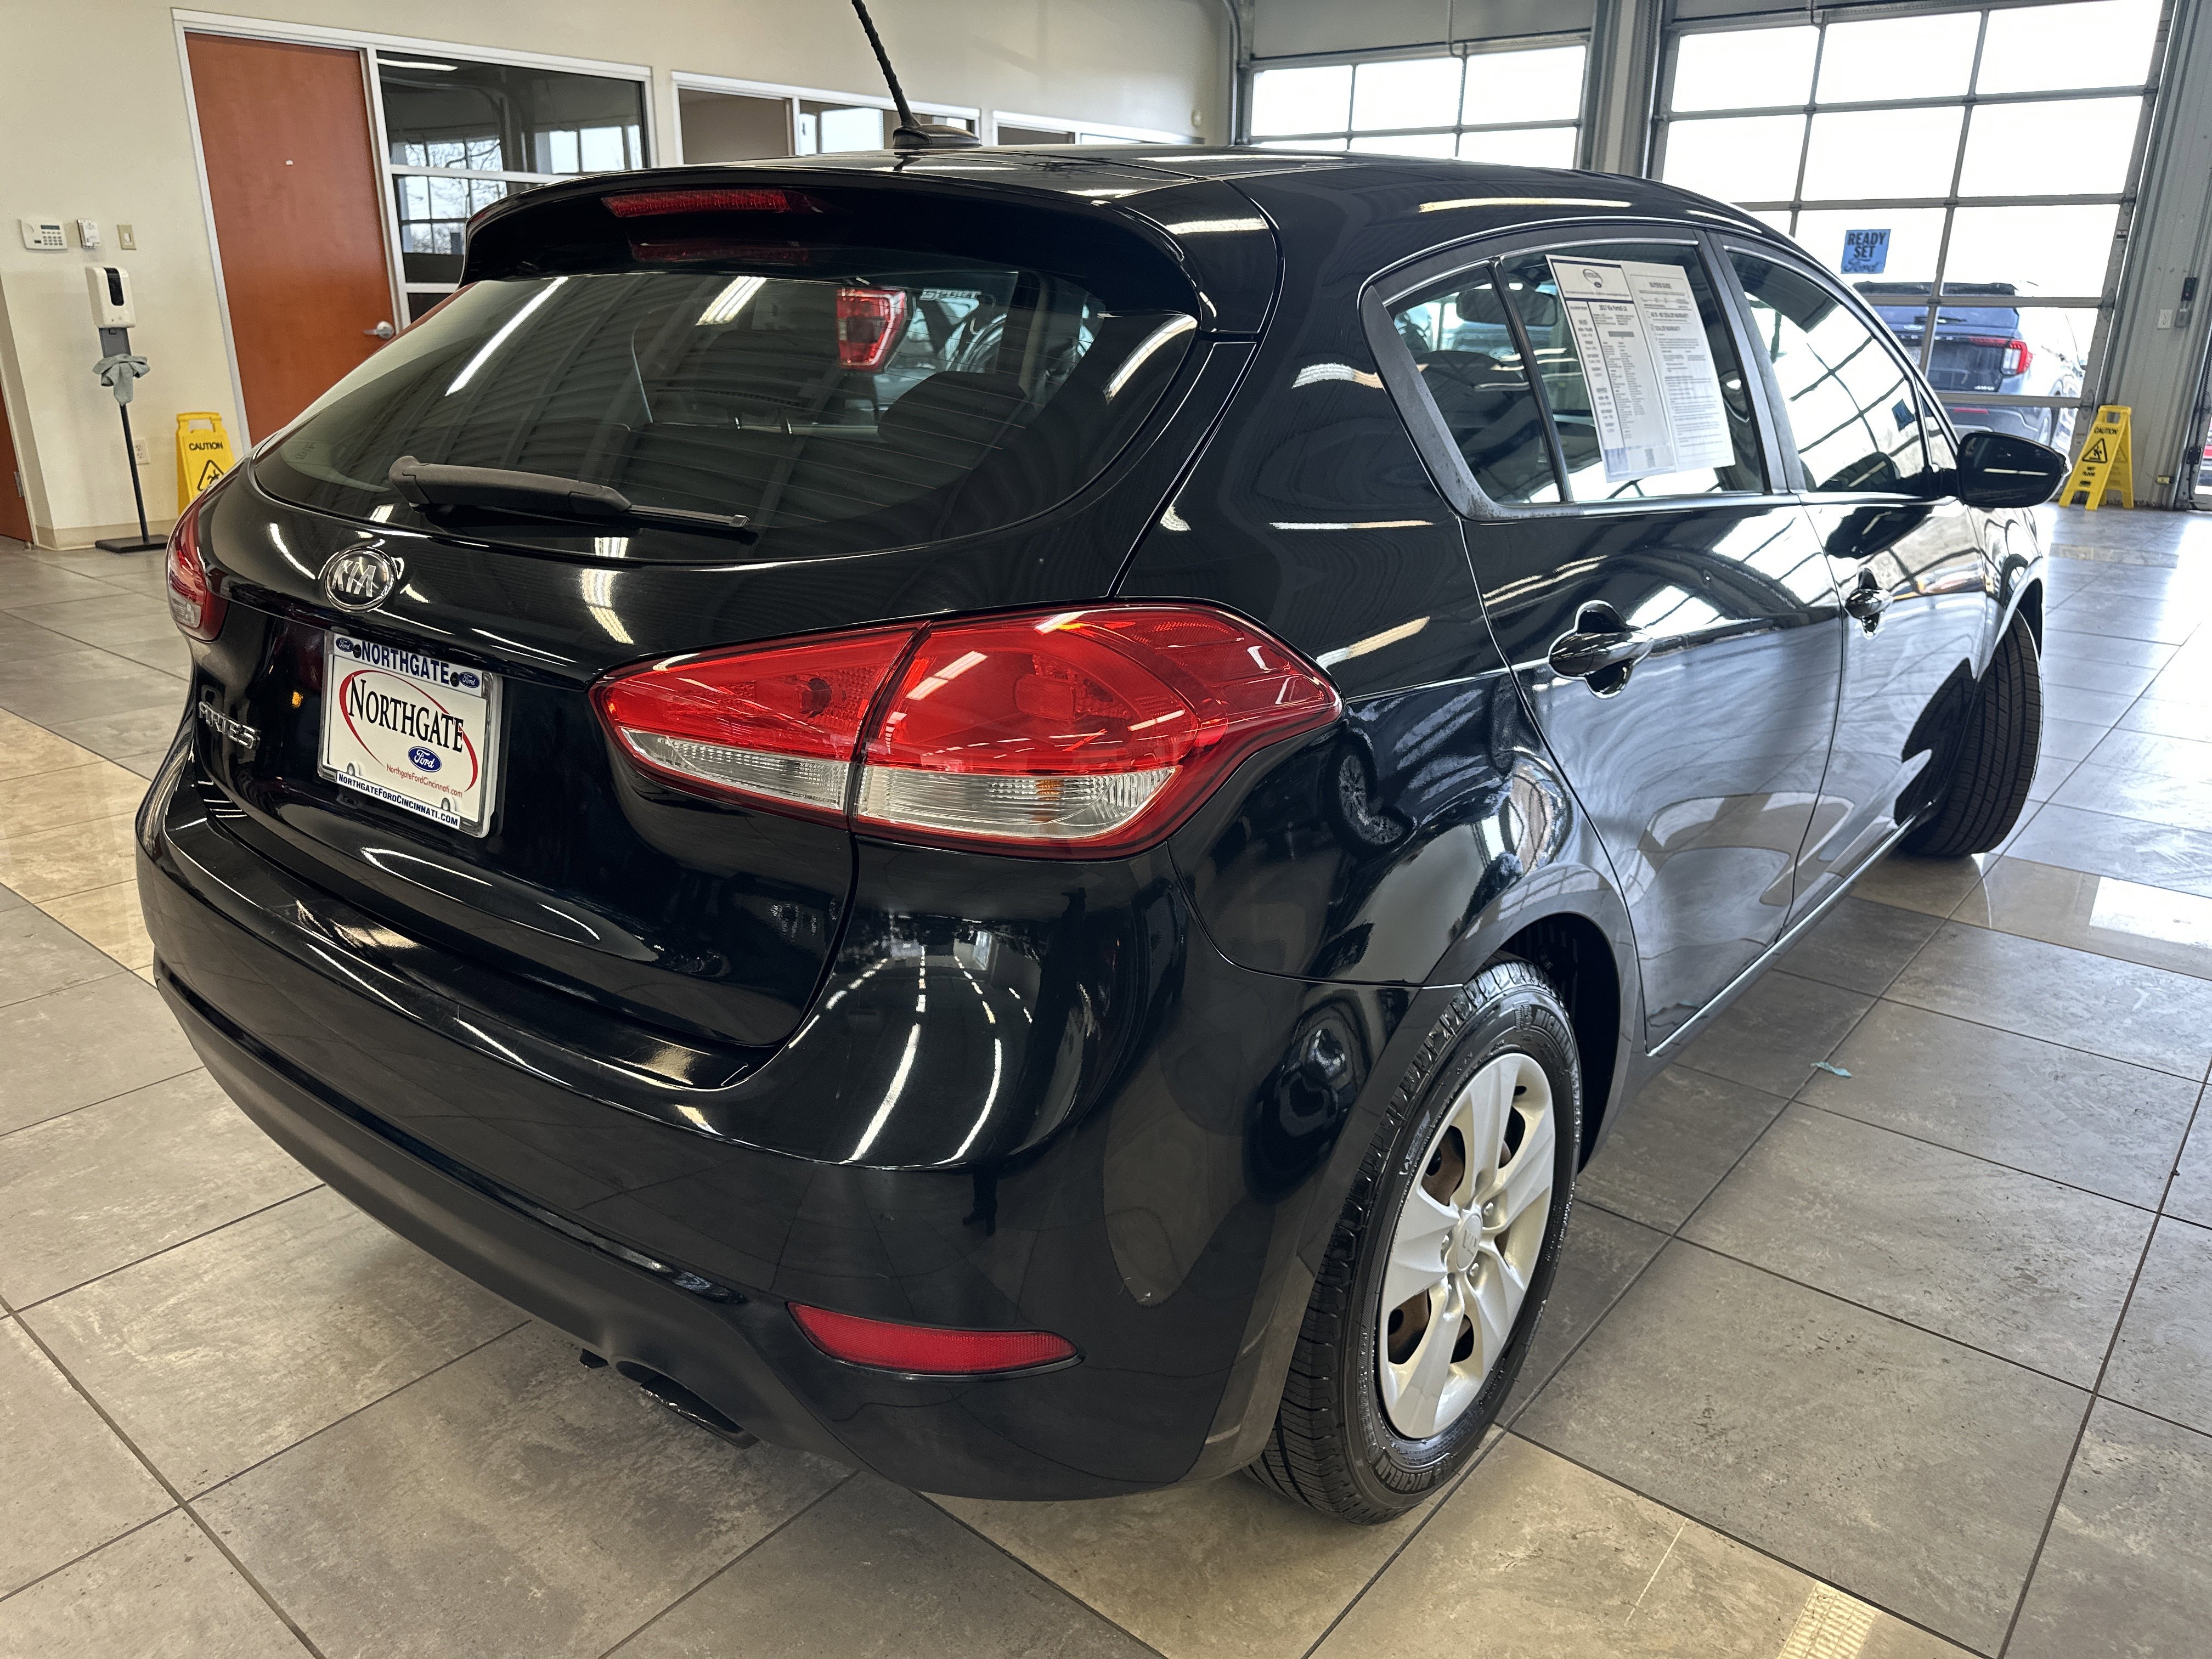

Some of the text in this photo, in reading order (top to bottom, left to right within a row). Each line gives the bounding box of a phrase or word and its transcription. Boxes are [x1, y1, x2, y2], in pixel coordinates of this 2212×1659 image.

[1847, 232, 1887, 246] READY
[1854, 246, 1876, 258] SET
[1843, 258, 1883, 273] Ford
[2094, 427, 2118, 436] CAUTION
[189, 441, 224, 451] CAUTION
[362, 640, 450, 685] NORTHGATE
[348, 674, 464, 753] NORTHGATE
[413, 748, 437, 769] Ford
[386, 763, 463, 798] NorthgateFordCincinnati.com
[1533, 1008, 1575, 1069] MICHELIN
[1374, 1454, 1433, 1491] MICHELIN
